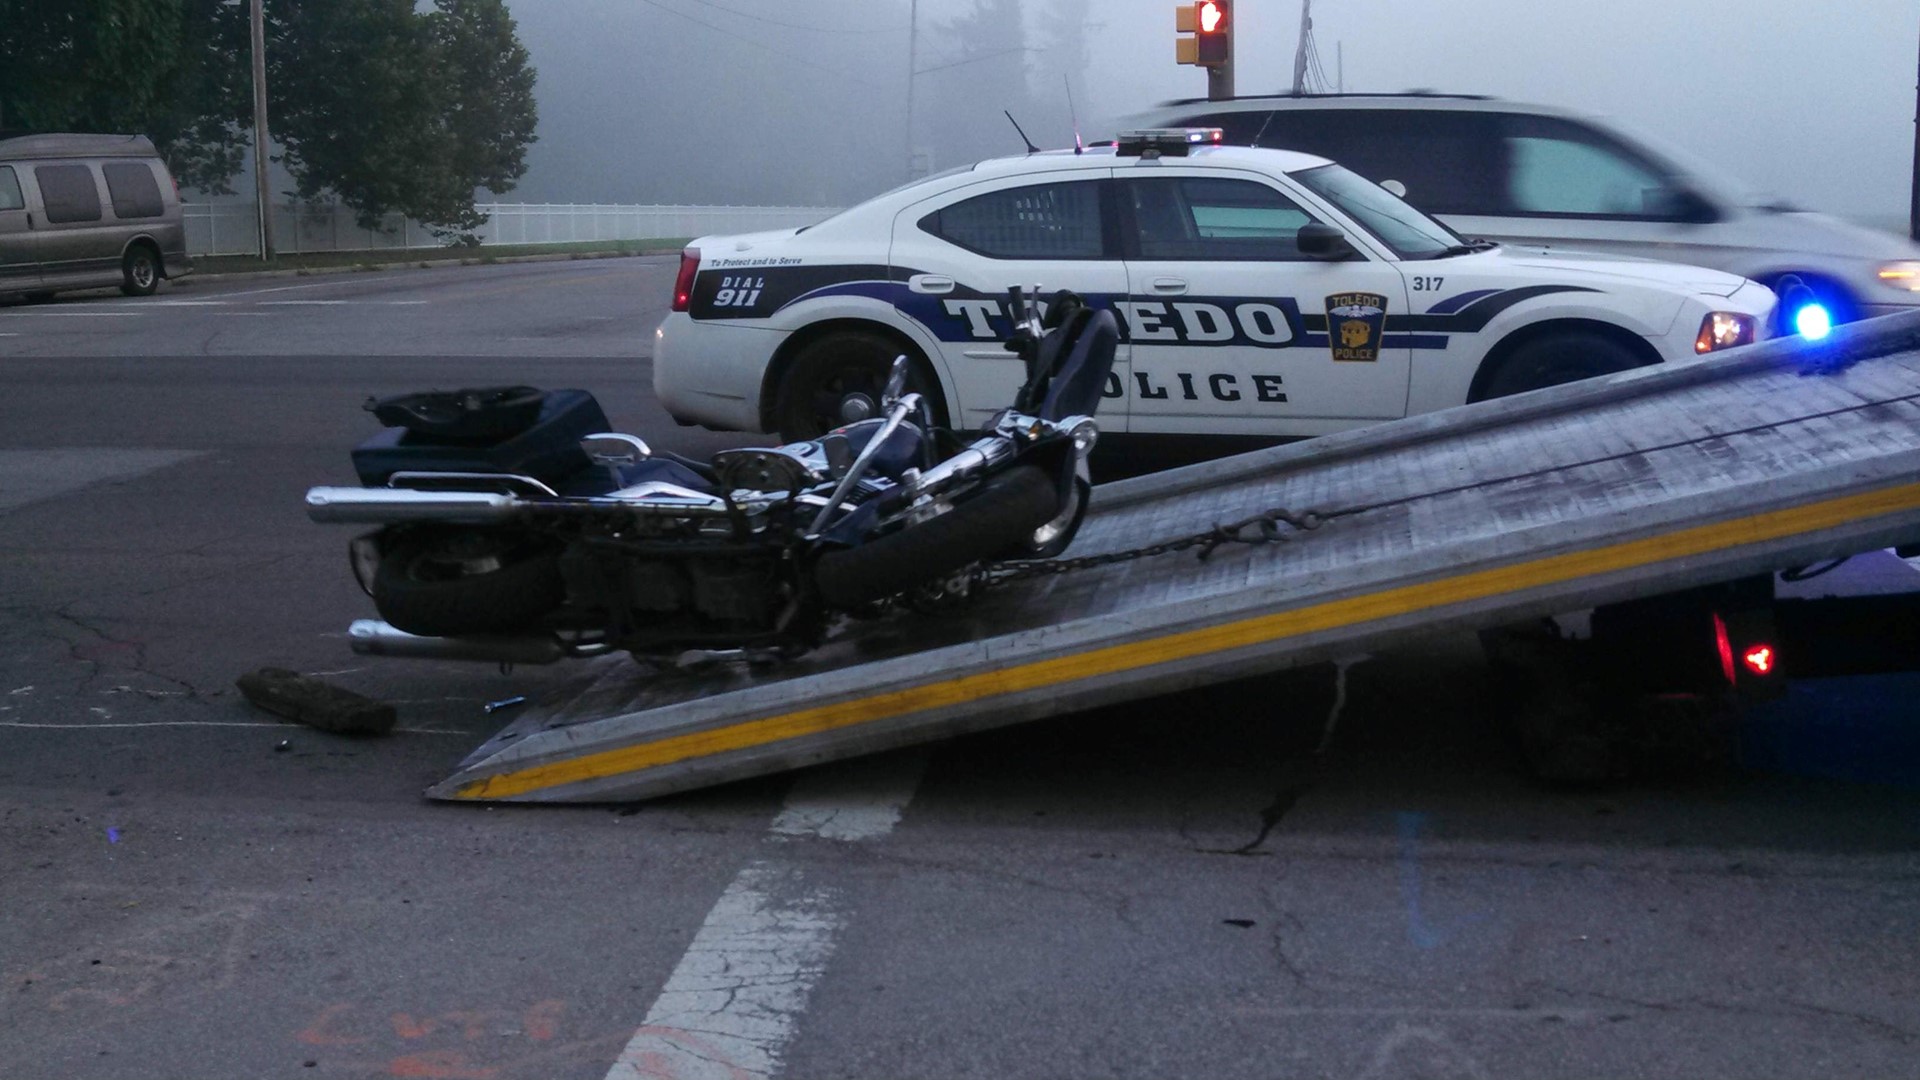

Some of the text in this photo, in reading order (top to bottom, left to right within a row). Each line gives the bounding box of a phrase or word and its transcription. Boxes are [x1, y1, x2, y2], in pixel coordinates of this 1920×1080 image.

[752, 257, 767, 265] and
[768, 257, 777, 265] to
[721, 277, 764, 288] DIAL
[1413, 276, 1444, 291] 317
[713, 289, 760, 306] 911
[1333, 294, 1379, 306] TOLEDO
[943, 299, 1293, 344] TEDO
[1334, 349, 1373, 359] POLICE
[1101, 371, 1289, 403] OLICE
